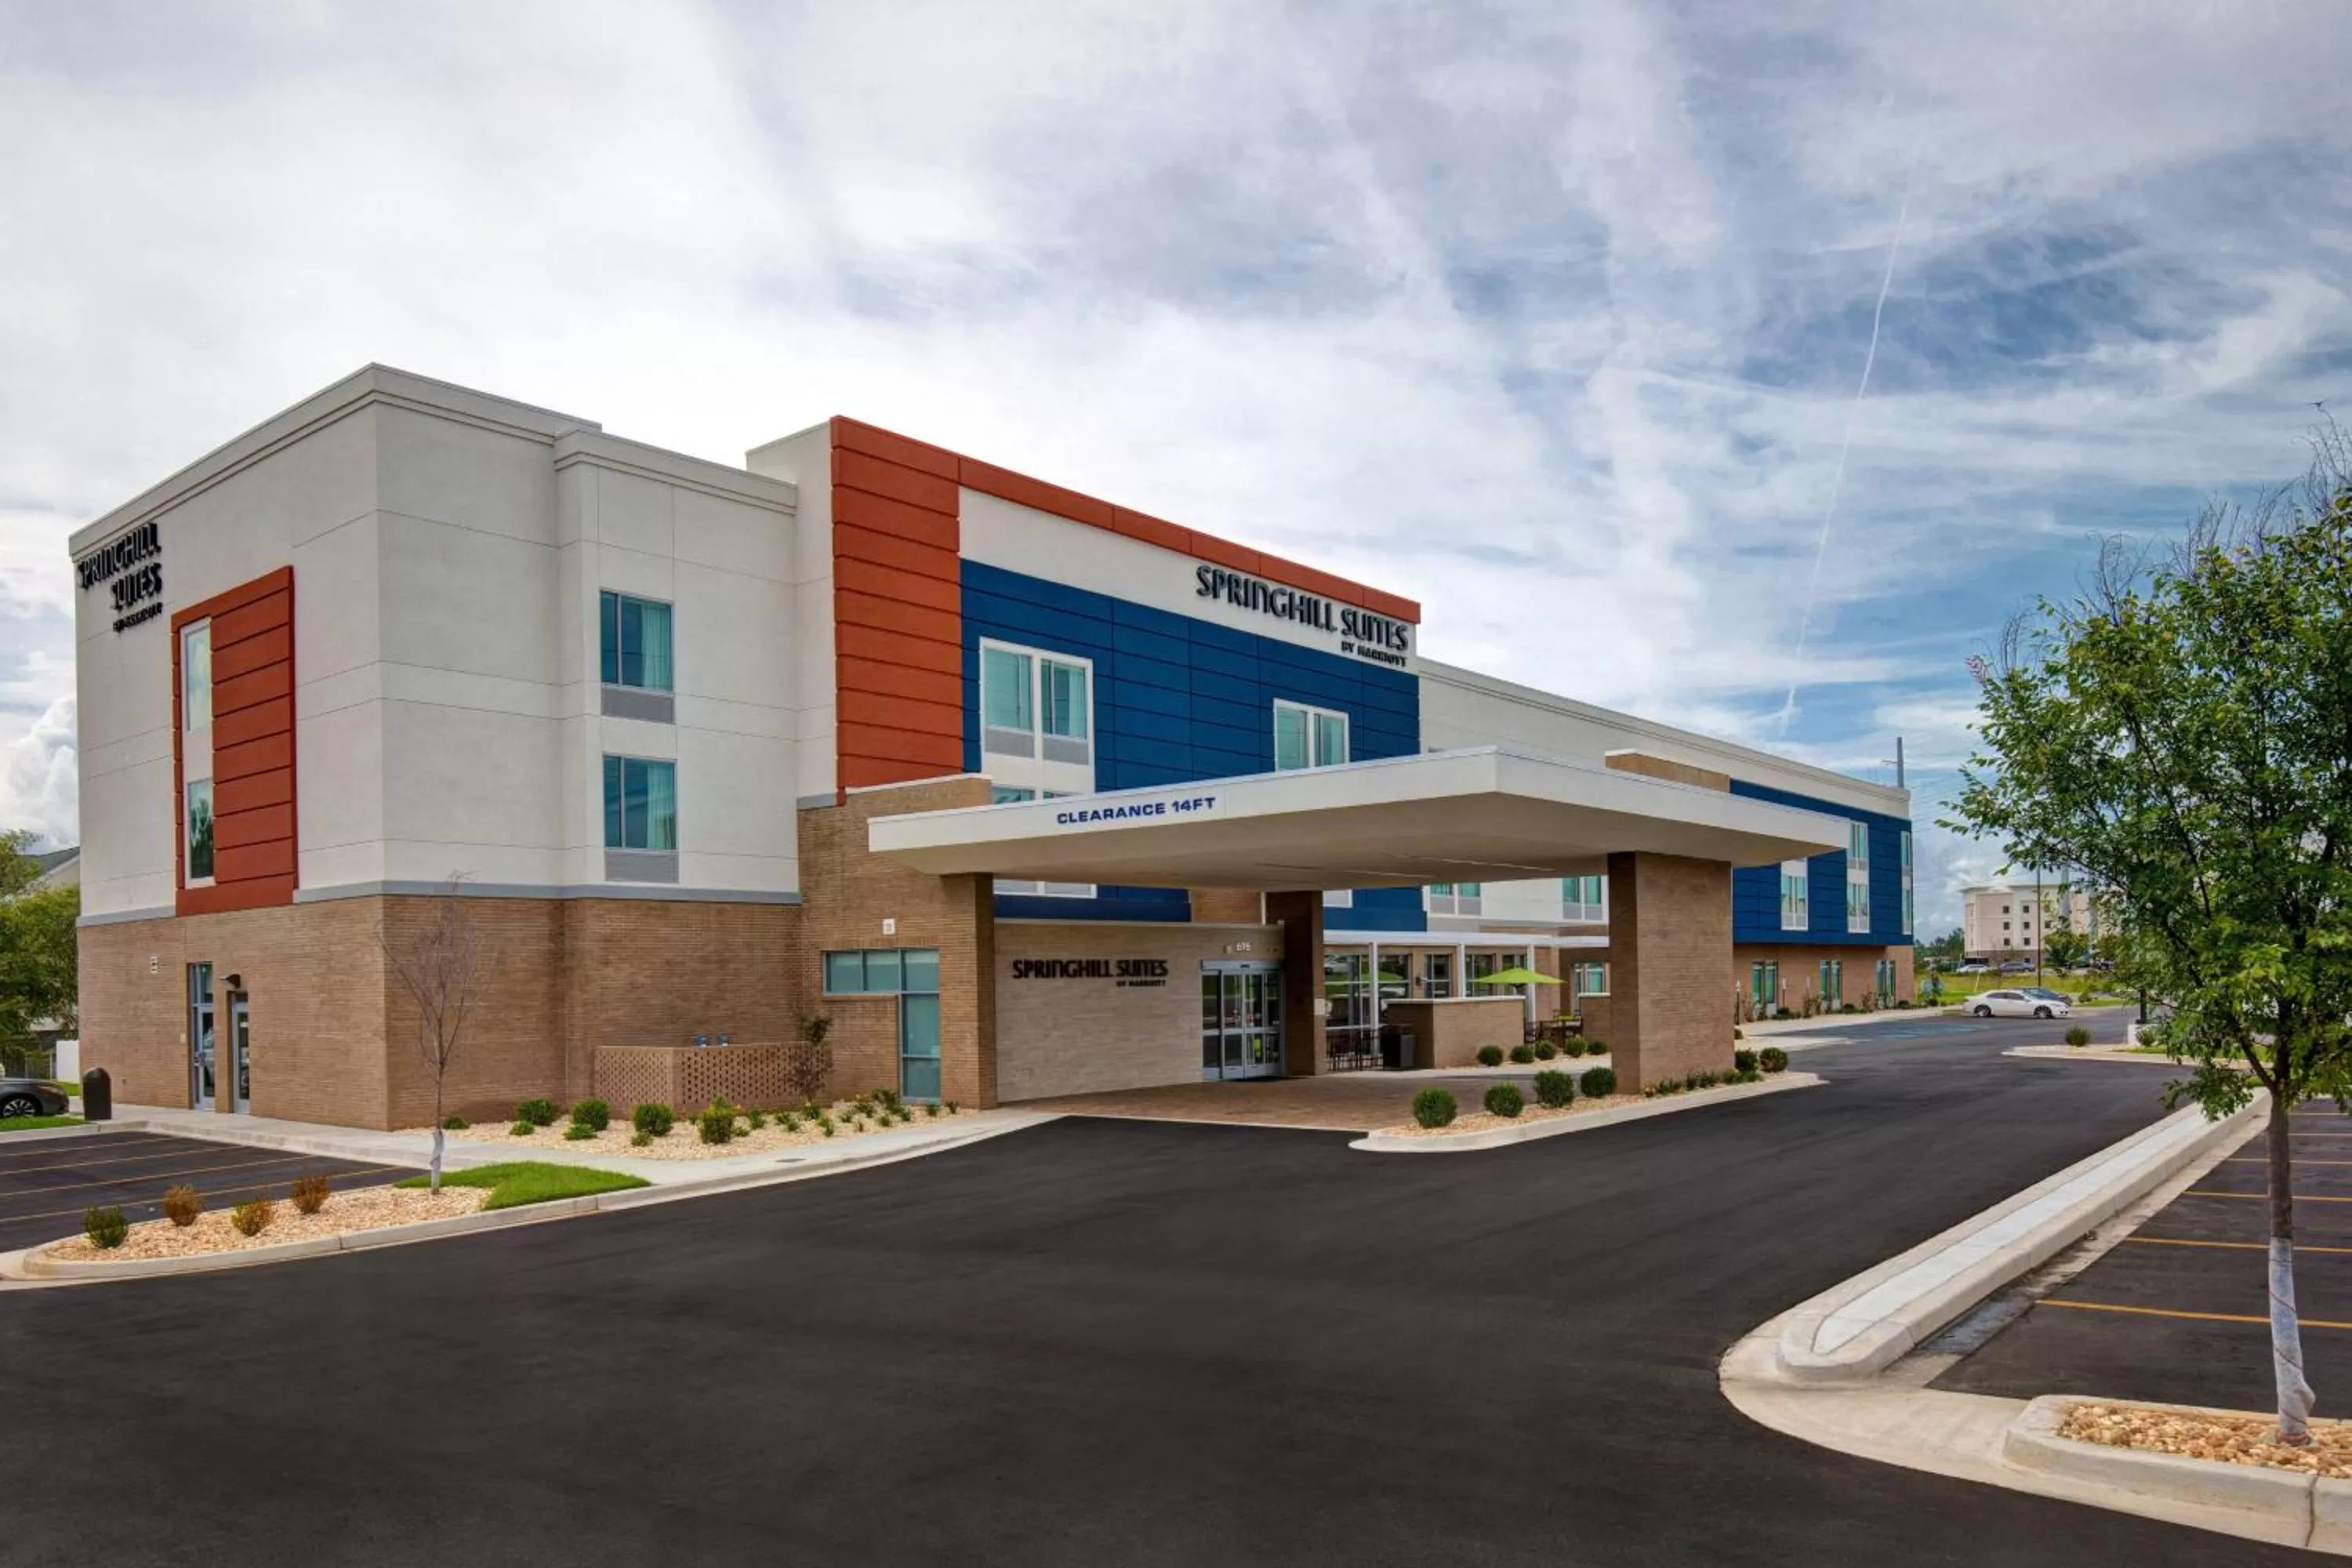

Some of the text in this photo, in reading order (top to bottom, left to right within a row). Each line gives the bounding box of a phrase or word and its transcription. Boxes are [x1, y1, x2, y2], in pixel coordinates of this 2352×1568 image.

[78, 522, 162, 590] SPRINGHILL
[1196, 565, 1408, 651] SPRINGHILL SUITES
[1058, 797, 1215, 824] CLEARANCE 14FT
[1012, 960, 1168, 978] SPRINGHILL SUITES
